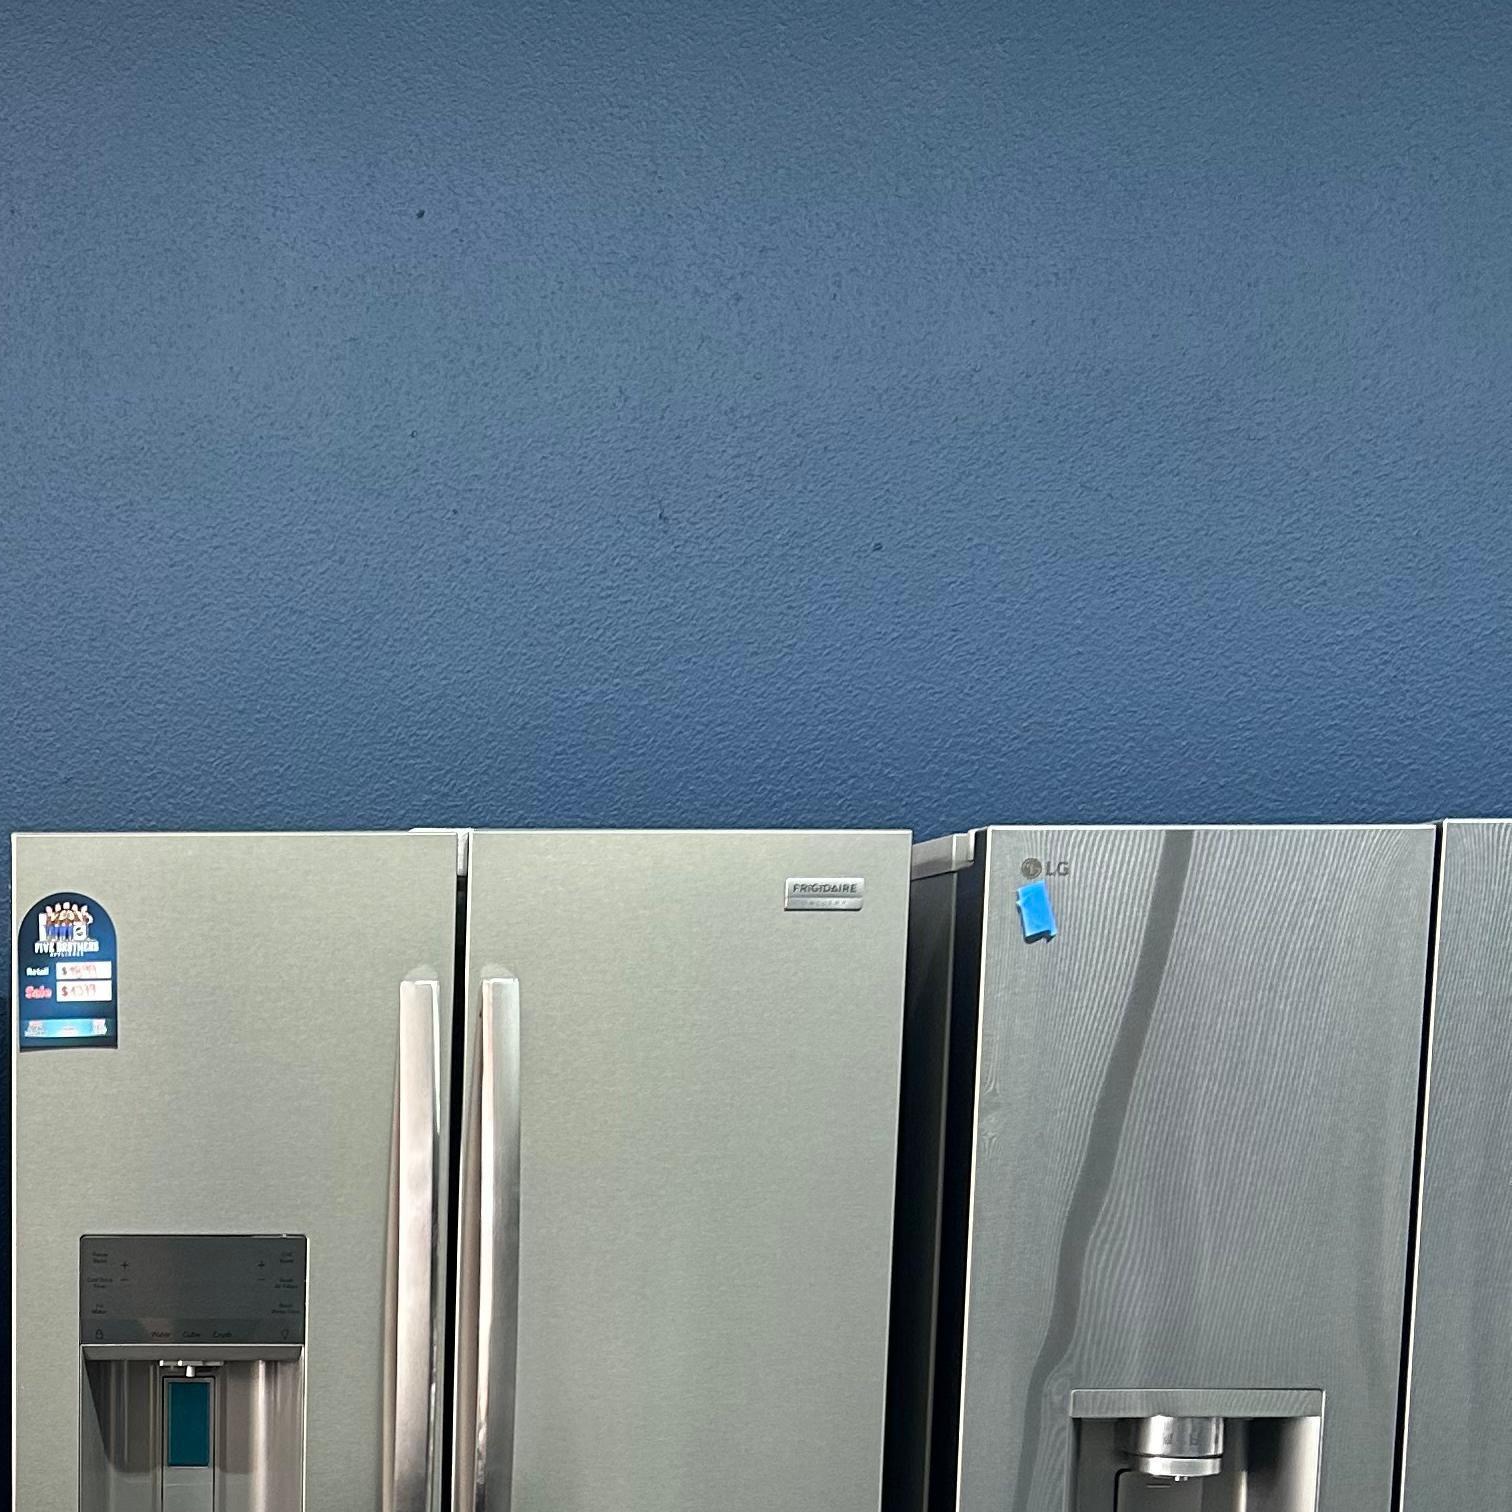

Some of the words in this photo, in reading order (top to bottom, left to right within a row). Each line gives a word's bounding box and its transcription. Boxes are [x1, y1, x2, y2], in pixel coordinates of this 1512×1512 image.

[1045, 861, 1069, 876] LG
[792, 883, 858, 893] FRIGIDAIRE
[25, 986, 52, 999] Sale
